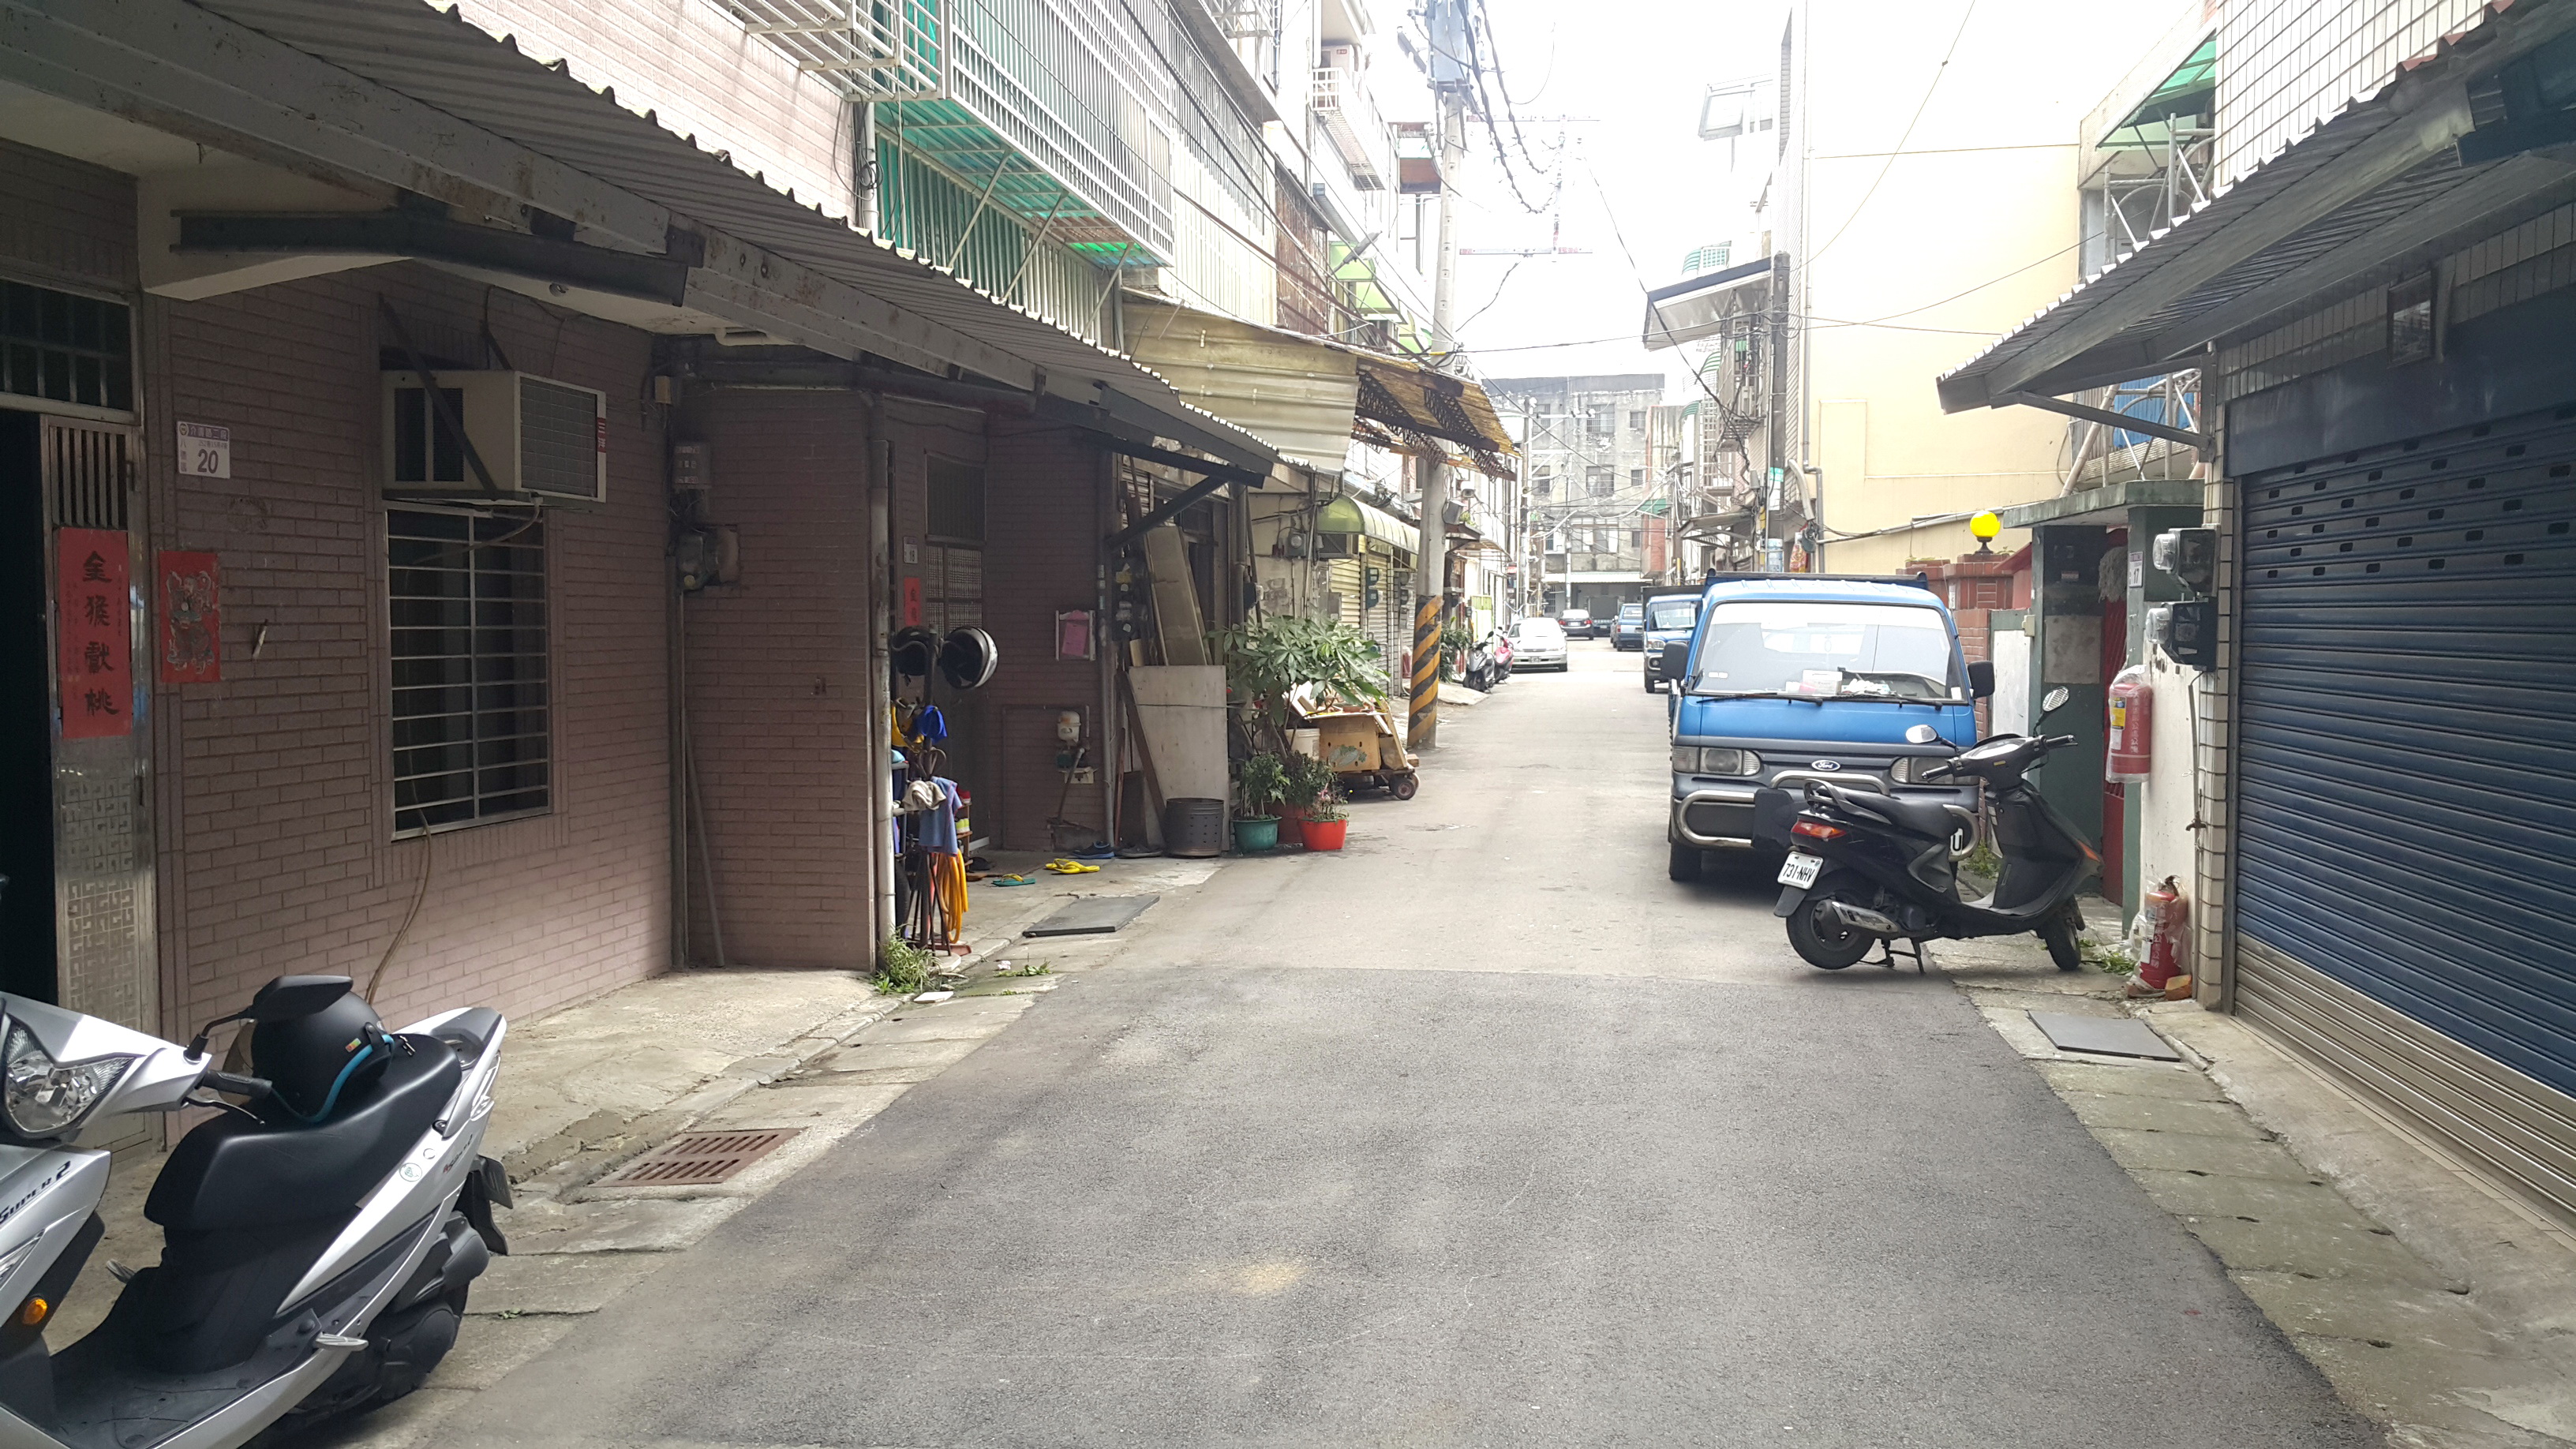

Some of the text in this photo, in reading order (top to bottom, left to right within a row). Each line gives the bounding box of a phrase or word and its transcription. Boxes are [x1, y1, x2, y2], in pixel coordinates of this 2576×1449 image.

[197, 448, 219, 474] 20
[2133, 567, 2140, 584] 17
[1783, 863, 1815, 882] 731-NHV
[56, 1160, 70, 1181] 2
